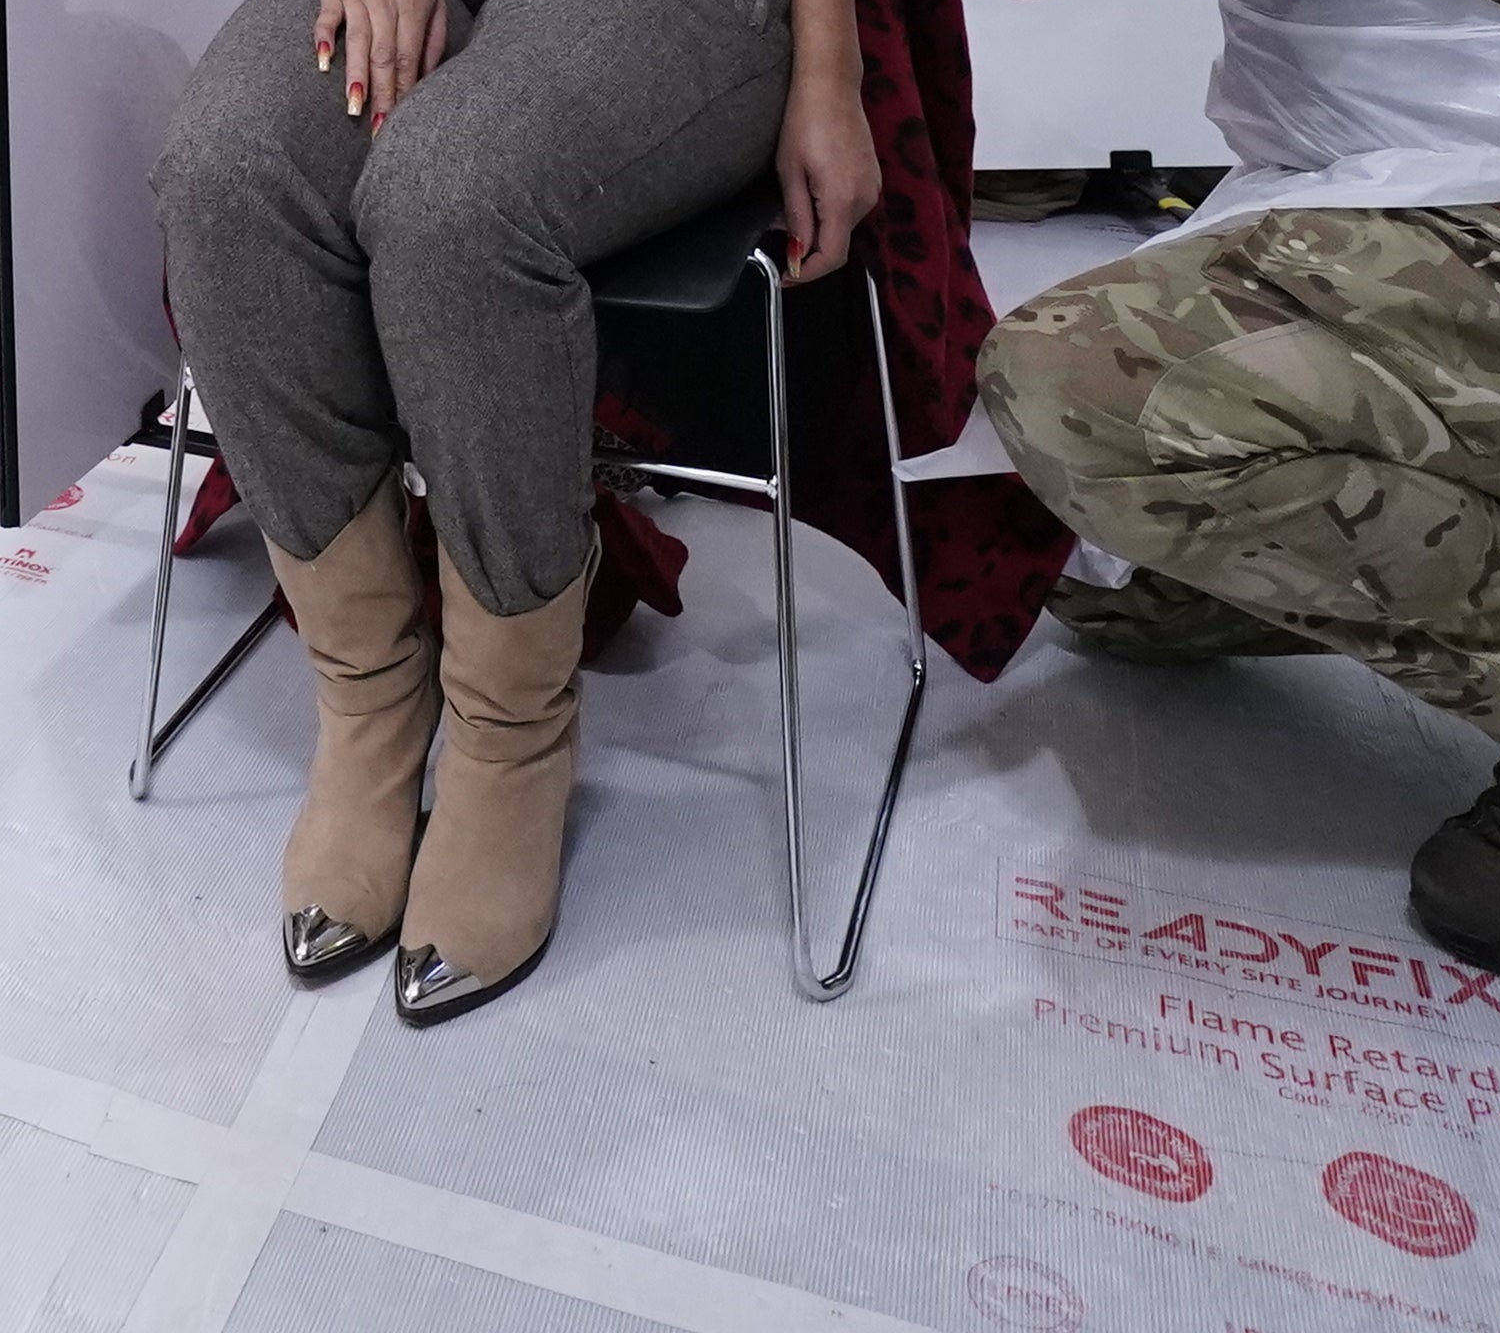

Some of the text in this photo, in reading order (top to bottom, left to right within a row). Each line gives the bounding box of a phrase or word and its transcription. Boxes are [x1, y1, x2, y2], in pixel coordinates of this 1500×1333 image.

[1013, 918, 1451, 1022] PART OF EVERY SITE JOURNEY
[1032, 997, 1241, 1073] Premium
[1260, 1052, 1446, 1112] Surface
[1159, 993, 1307, 1052] Flame
